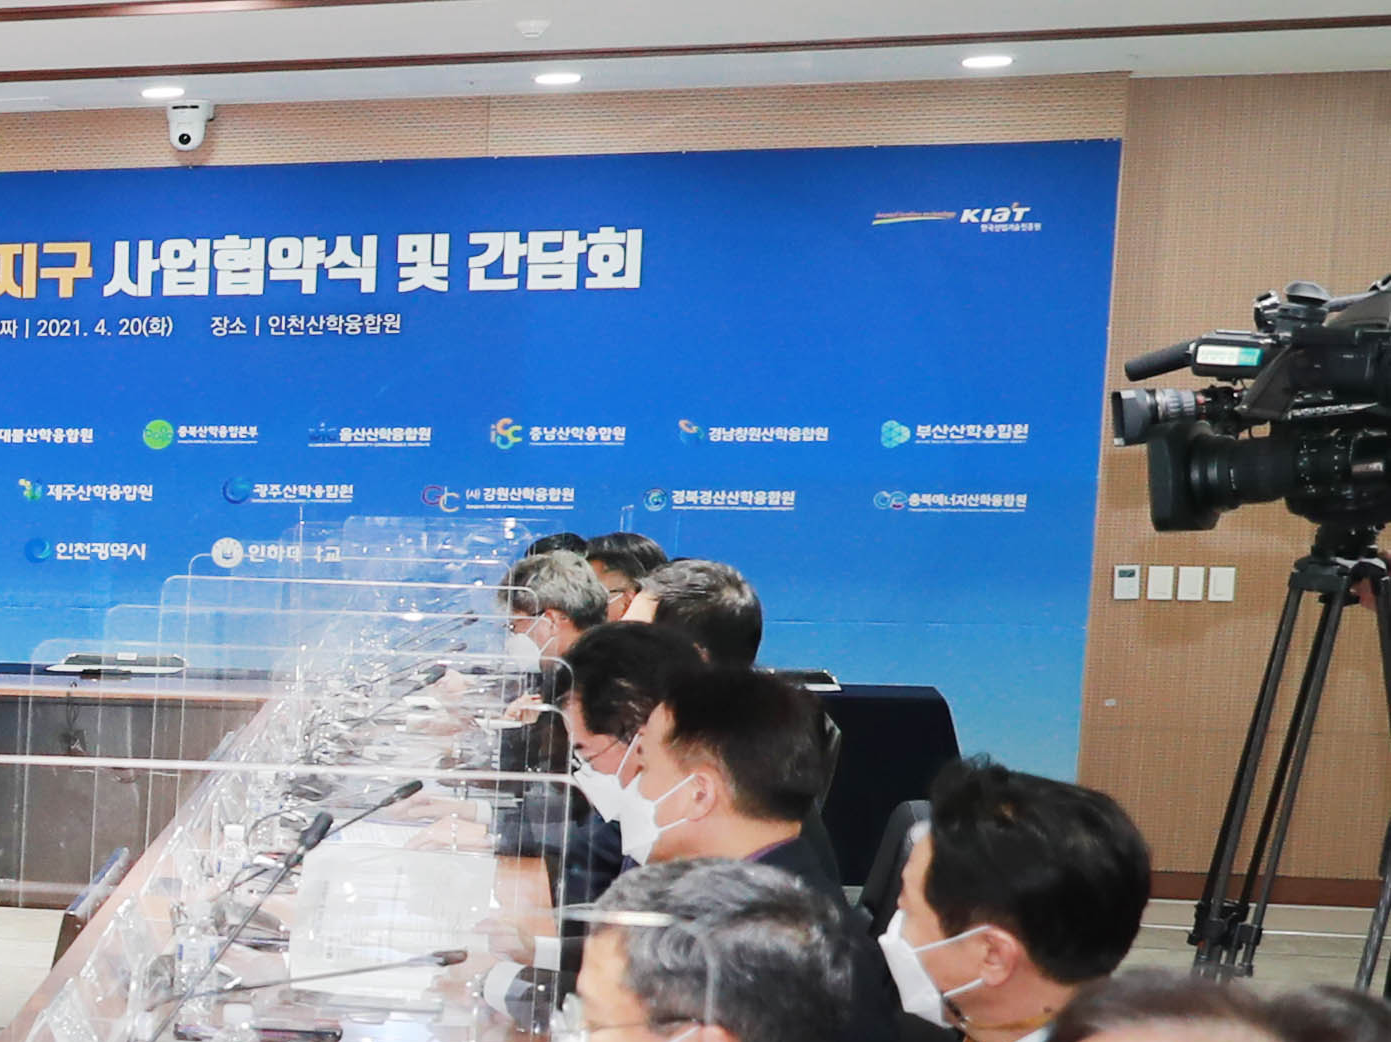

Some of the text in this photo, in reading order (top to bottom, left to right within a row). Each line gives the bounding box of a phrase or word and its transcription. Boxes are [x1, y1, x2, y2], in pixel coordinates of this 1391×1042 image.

[102, 234, 378, 298] 사업협약식
[396, 233, 450, 292] 및
[467, 226, 643, 291] 간담회
[36, 319, 88, 337] 2021.
[94, 319, 112, 337] 4.
[118, 316, 174, 338] 20(화)
[210, 314, 401, 337] 장소 인천산학융합원
[177, 425, 259, 439] 충북산학융합본부
[339, 426, 432, 442] 울산산학융합원
[529, 426, 626, 441] 충남산학융합원
[708, 426, 829, 442] 경남창원산학융합원
[915, 423, 1029, 440] 부산산학융합원
[46, 484, 154, 502] 제주산학융합원
[252, 484, 354, 499] 광주산학융합원
[483, 487, 575, 502] 강원산학융합원
[671, 490, 796, 506] 경북경산산학융합원
[55, 543, 147, 561] 인천광역시
